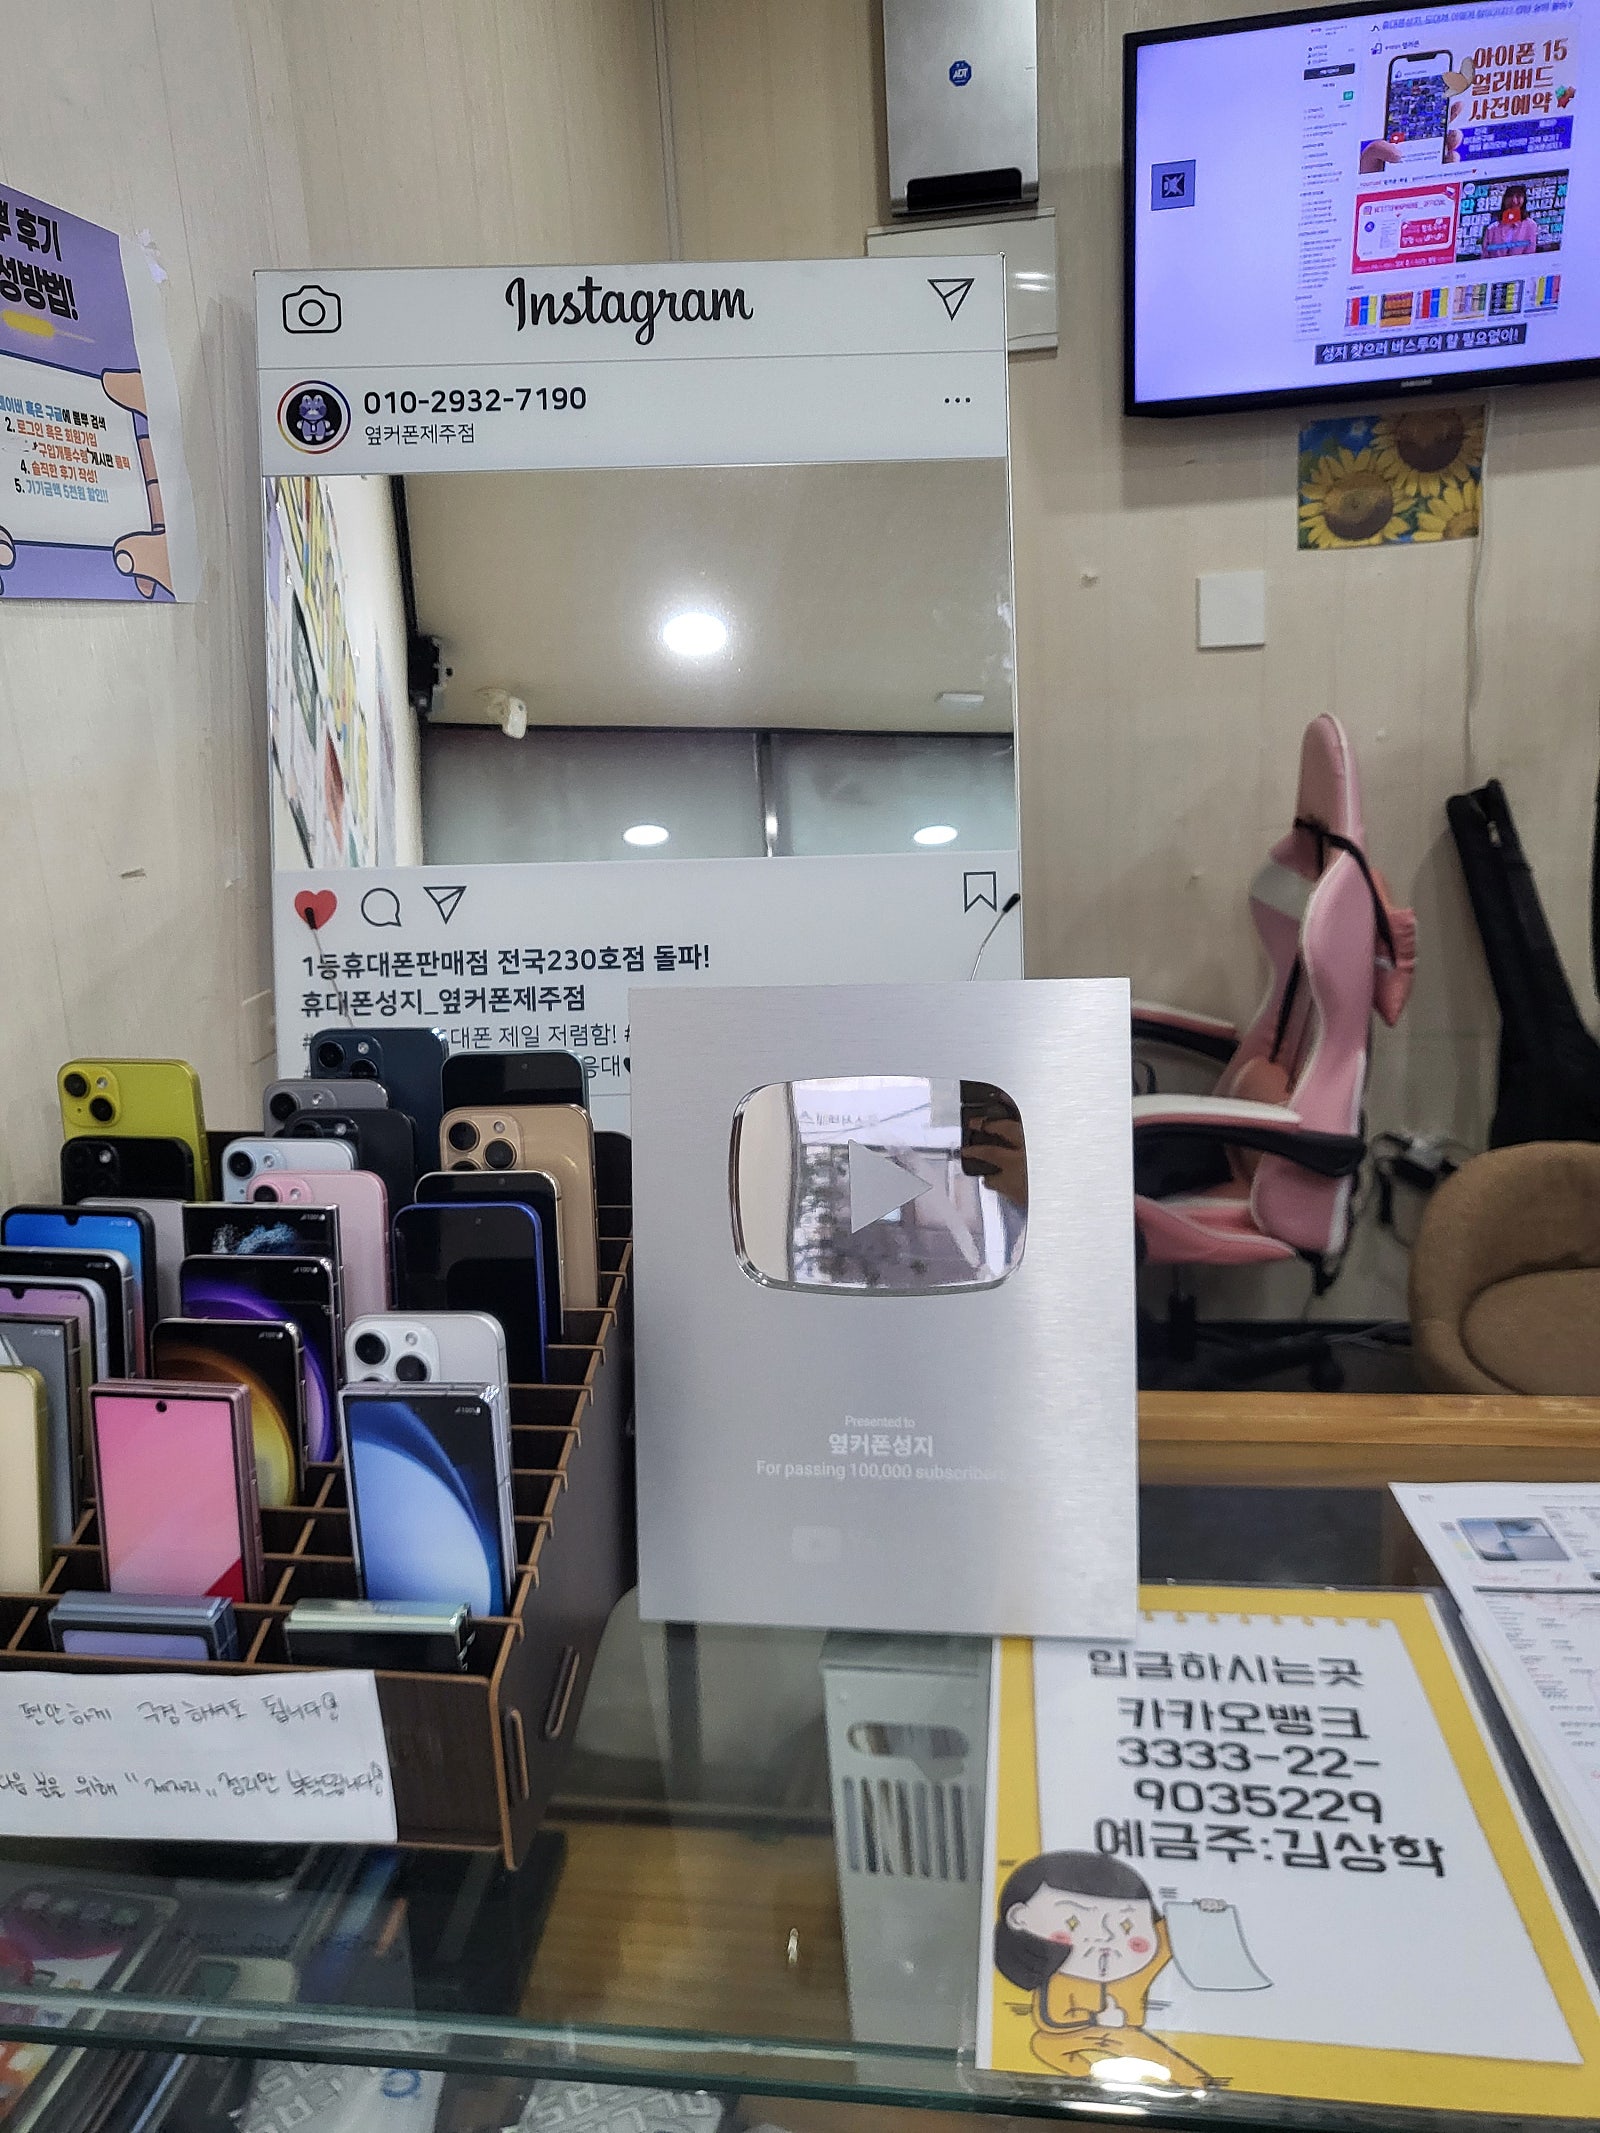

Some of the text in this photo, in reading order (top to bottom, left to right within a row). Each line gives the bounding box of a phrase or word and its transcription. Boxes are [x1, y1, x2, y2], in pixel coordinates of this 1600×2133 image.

[1473, 38, 1568, 69] 아이폰 15
[1472, 66, 1553, 96] 얼리버드
[1468, 91, 1553, 121] 사전예약
[15, 207, 62, 262] 후기
[504, 275, 754, 346] Instagram
[363, 385, 587, 416] 010-2932-7190
[5, 417, 98, 447] 2. 로그인 혹은 회원가입
[90, 415, 107, 432] 검색
[363, 422, 476, 447] 옆커폰제주점
[20, 459, 98, 484] 4. 솔직한 후기 작성!
[14, 478, 25, 493] 5.
[63, 484, 86, 501] 5천원
[302, 944, 711, 980] 1등휴대폰판매점 전국230호점 돌파!
[300, 984, 586, 1020] 휴대폰성지_옆커폰제주점
[498, 1024, 540, 1048] 제일
[547, 1023, 617, 1047] 저렴함!
[844, 1415, 916, 1429] Presented to
[828, 1432, 934, 1458] 옆커폰성지
[755, 1460, 781, 1476] For
[785, 1460, 846, 1481] passing
[850, 1462, 912, 1481] 100,000
[1089, 1648, 1366, 1689] 입금하시는곳
[1116, 1697, 1370, 1741] 카카오뱅크
[1117, 1736, 1381, 1780] 3333-22-
[1133, 1777, 1384, 1825] 9035229
[1094, 1816, 1447, 1879] 예금주:김상학
